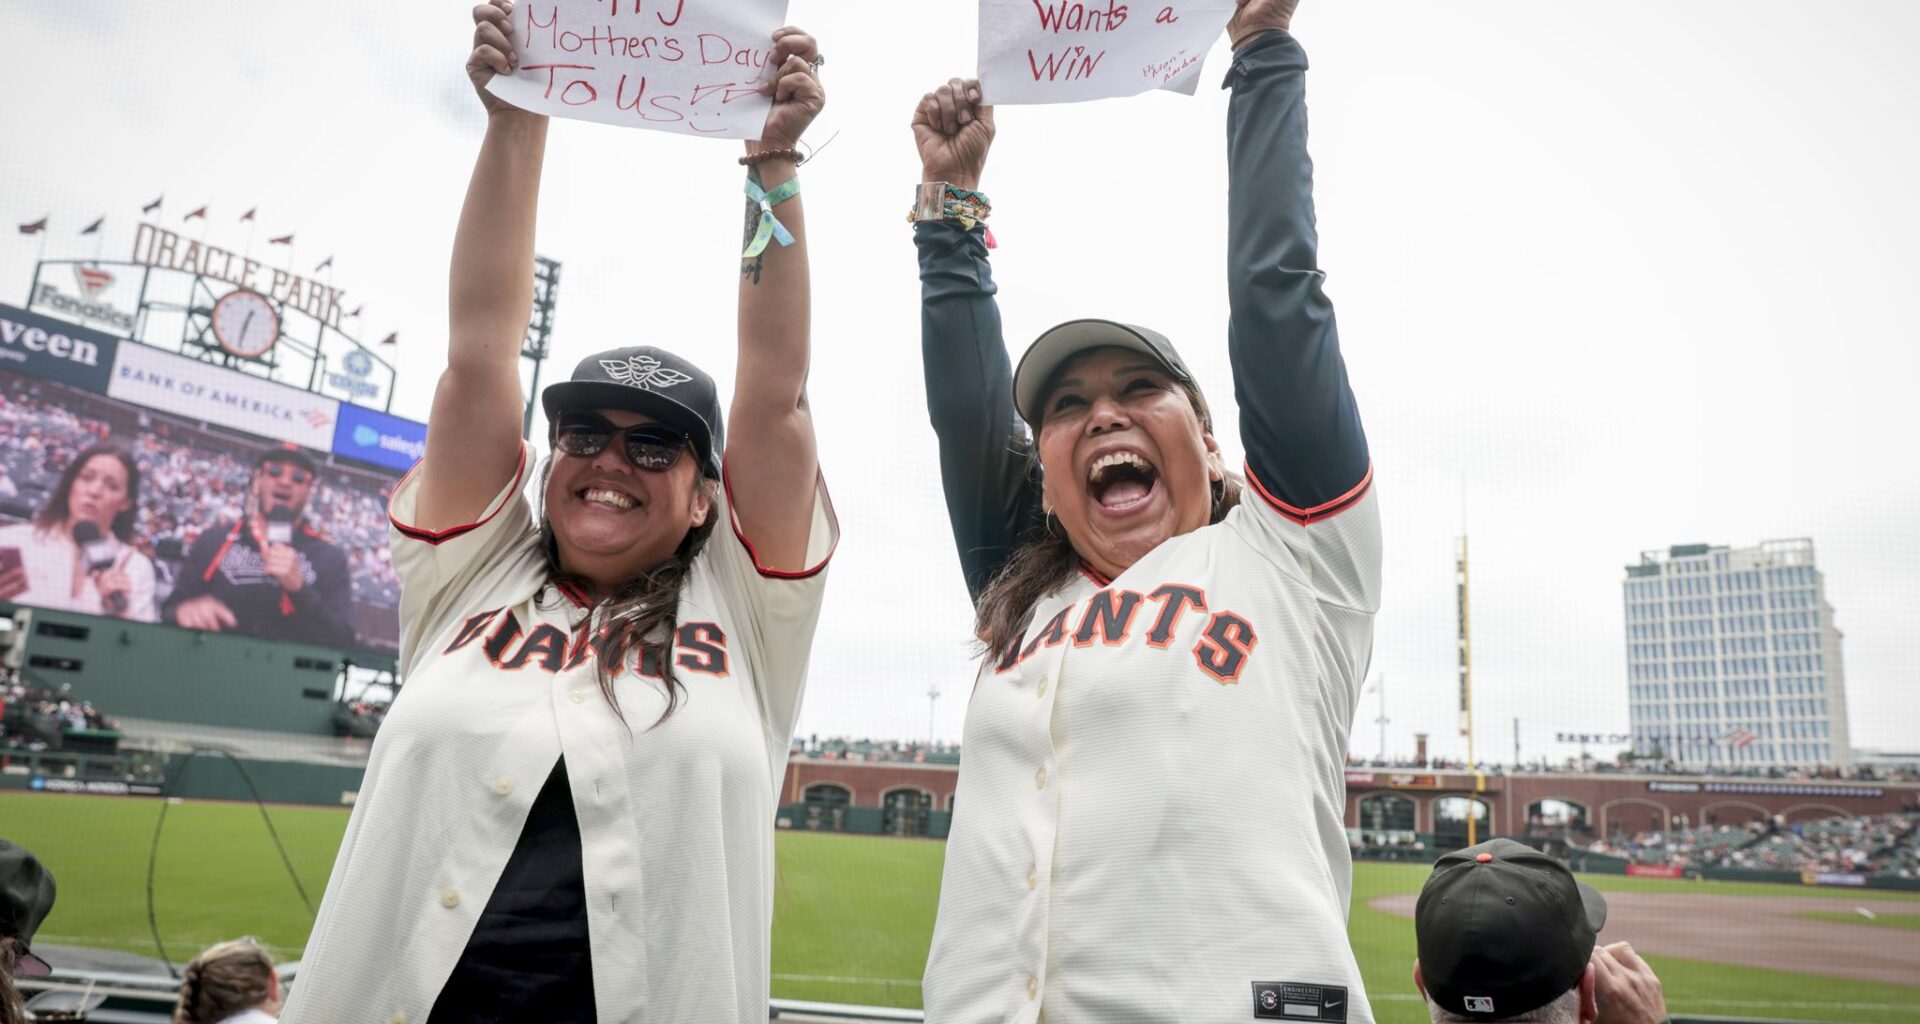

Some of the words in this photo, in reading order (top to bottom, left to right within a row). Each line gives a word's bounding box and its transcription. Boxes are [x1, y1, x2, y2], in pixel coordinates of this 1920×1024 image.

[525, 4, 684, 62] Mother's
[697, 33, 771, 85] Day
[1033, 0, 1128, 33] Wants
[1155, 6, 1179, 24] a
[134, 222, 260, 290] ORACLE
[270, 267, 345, 330] PARK
[38, 284, 134, 330] Fanatics
[120, 365, 175, 390] BANK
[180, 381, 205, 397] OF
[210, 390, 294, 421] AMERICA
